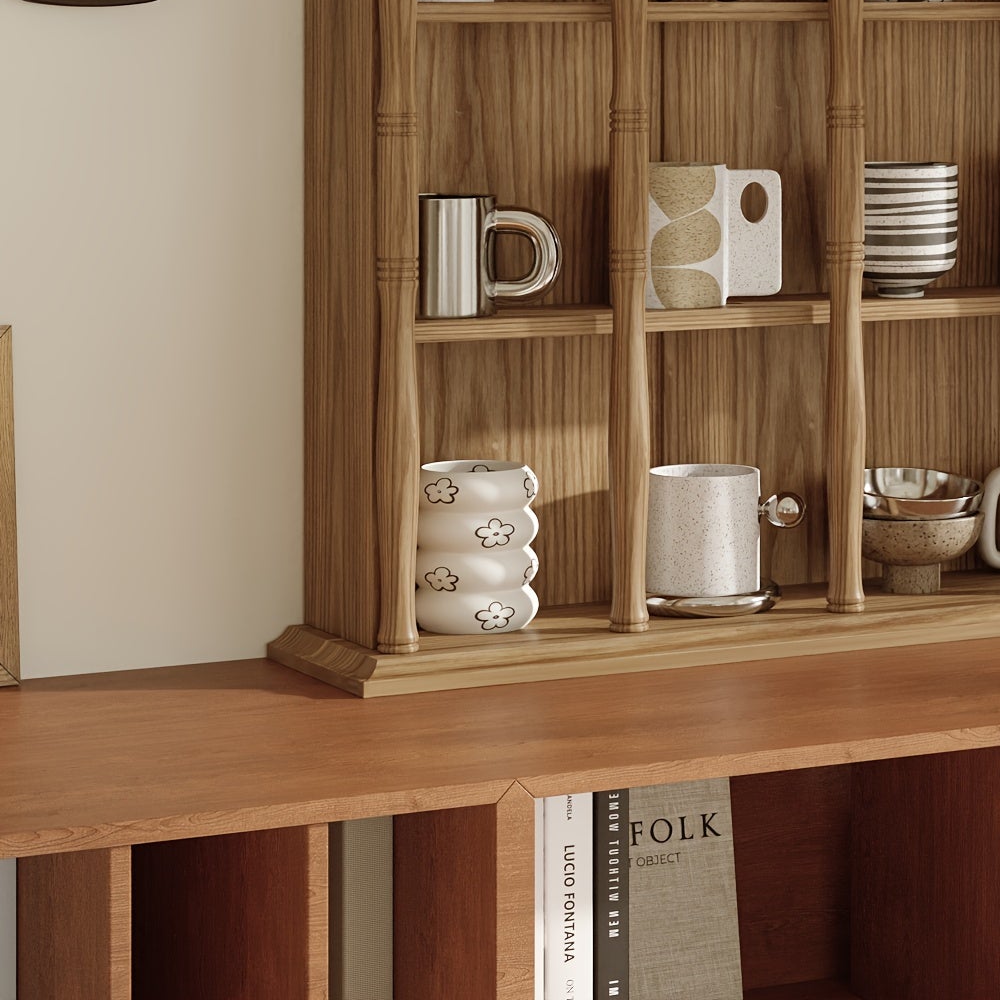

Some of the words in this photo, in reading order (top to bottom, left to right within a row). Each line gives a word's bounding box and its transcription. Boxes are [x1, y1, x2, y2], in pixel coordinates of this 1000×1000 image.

[629, 812, 722, 847] FOLK
[563, 844, 576, 888] LUCIO
[636, 852, 681, 868] OBJECT
[563, 892, 576, 963] FONTANA
[566, 979, 574, 994] ON
